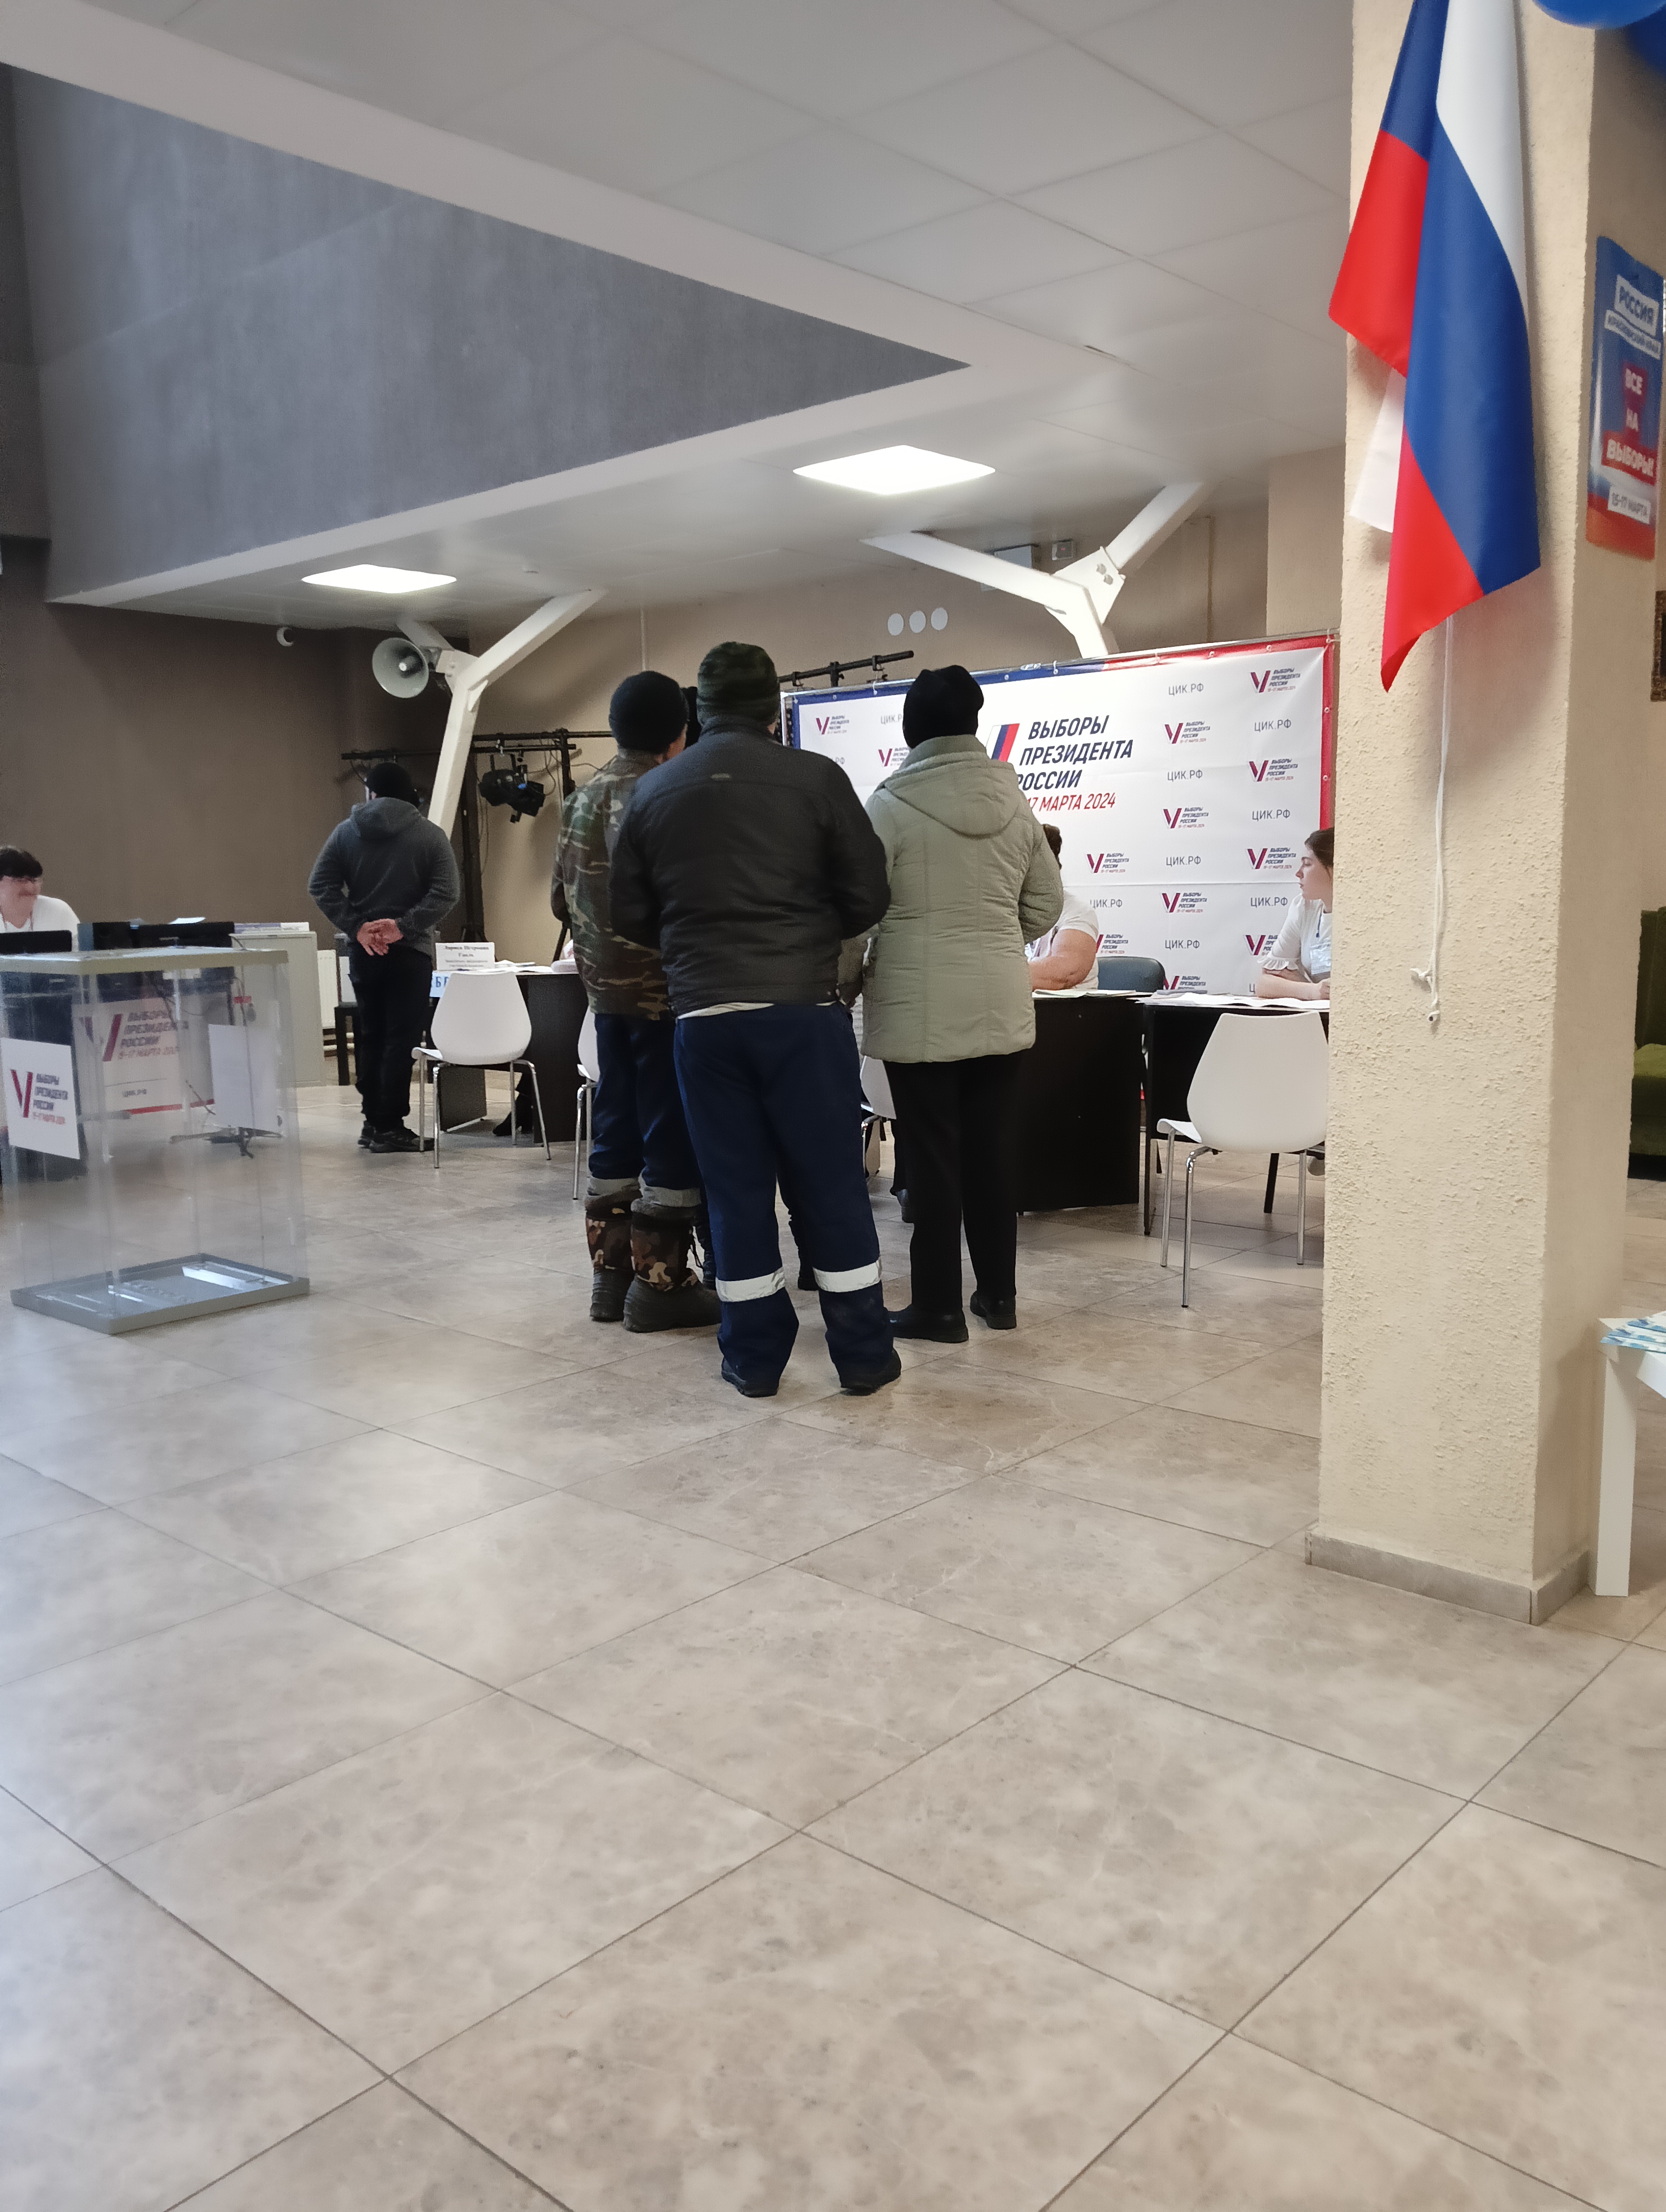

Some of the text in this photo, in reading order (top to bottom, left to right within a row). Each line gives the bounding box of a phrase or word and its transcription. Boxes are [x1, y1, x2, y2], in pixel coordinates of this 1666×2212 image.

[1625, 368, 1643, 395] ВСЕ
[1626, 408, 1639, 431] НА
[1169, 683, 1203, 697] ЦИК.РФ
[881, 714, 903, 725] ЦИК.Р
[1254, 719, 1292, 732] ЦИК.РФ
[1028, 715, 1110, 740] ВЫБОРЫ
[1020, 740, 1133, 766] ПРЕЗИДЕНТА
[1167, 769, 1203, 782] ЦИК.РФ
[1039, 795, 1082, 812] МАРТА
[1084, 792, 1116, 809] 2024
[1252, 809, 1290, 821] ЦИК.РФ
[1167, 856, 1201, 867] ЦИК.РФ
[1251, 897, 1288, 908] ЦИК.РФ
[1165, 940, 1200, 950] ЦИК.РФ
